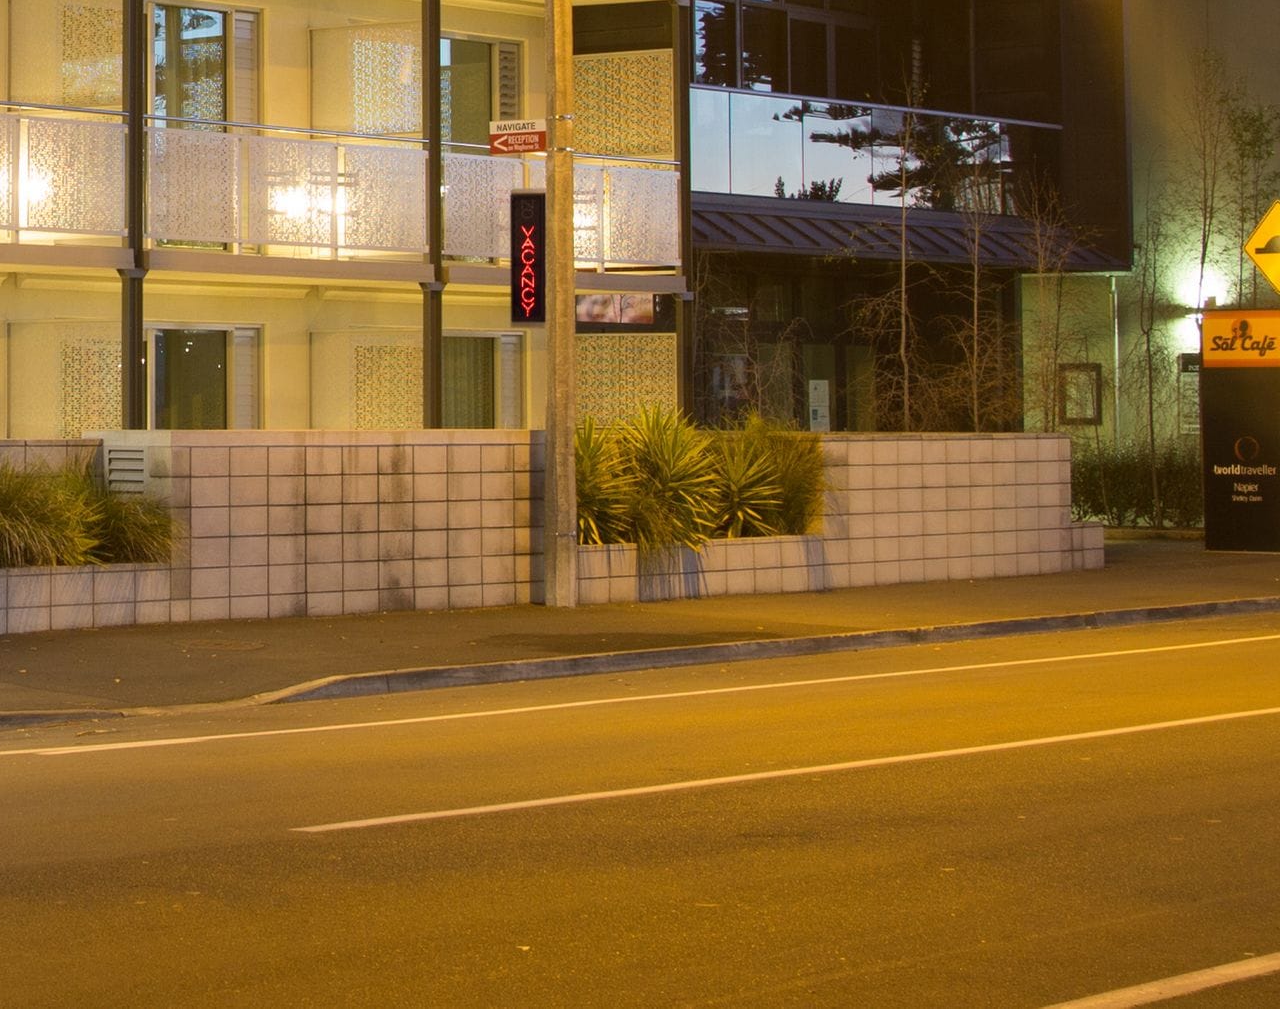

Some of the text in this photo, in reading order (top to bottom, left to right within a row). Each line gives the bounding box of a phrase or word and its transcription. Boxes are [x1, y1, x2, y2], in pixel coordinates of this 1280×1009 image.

[496, 122, 536, 132] NAVIGATE
[508, 134, 539, 144] RECEPTION
[521, 225, 535, 318] VACANCY
